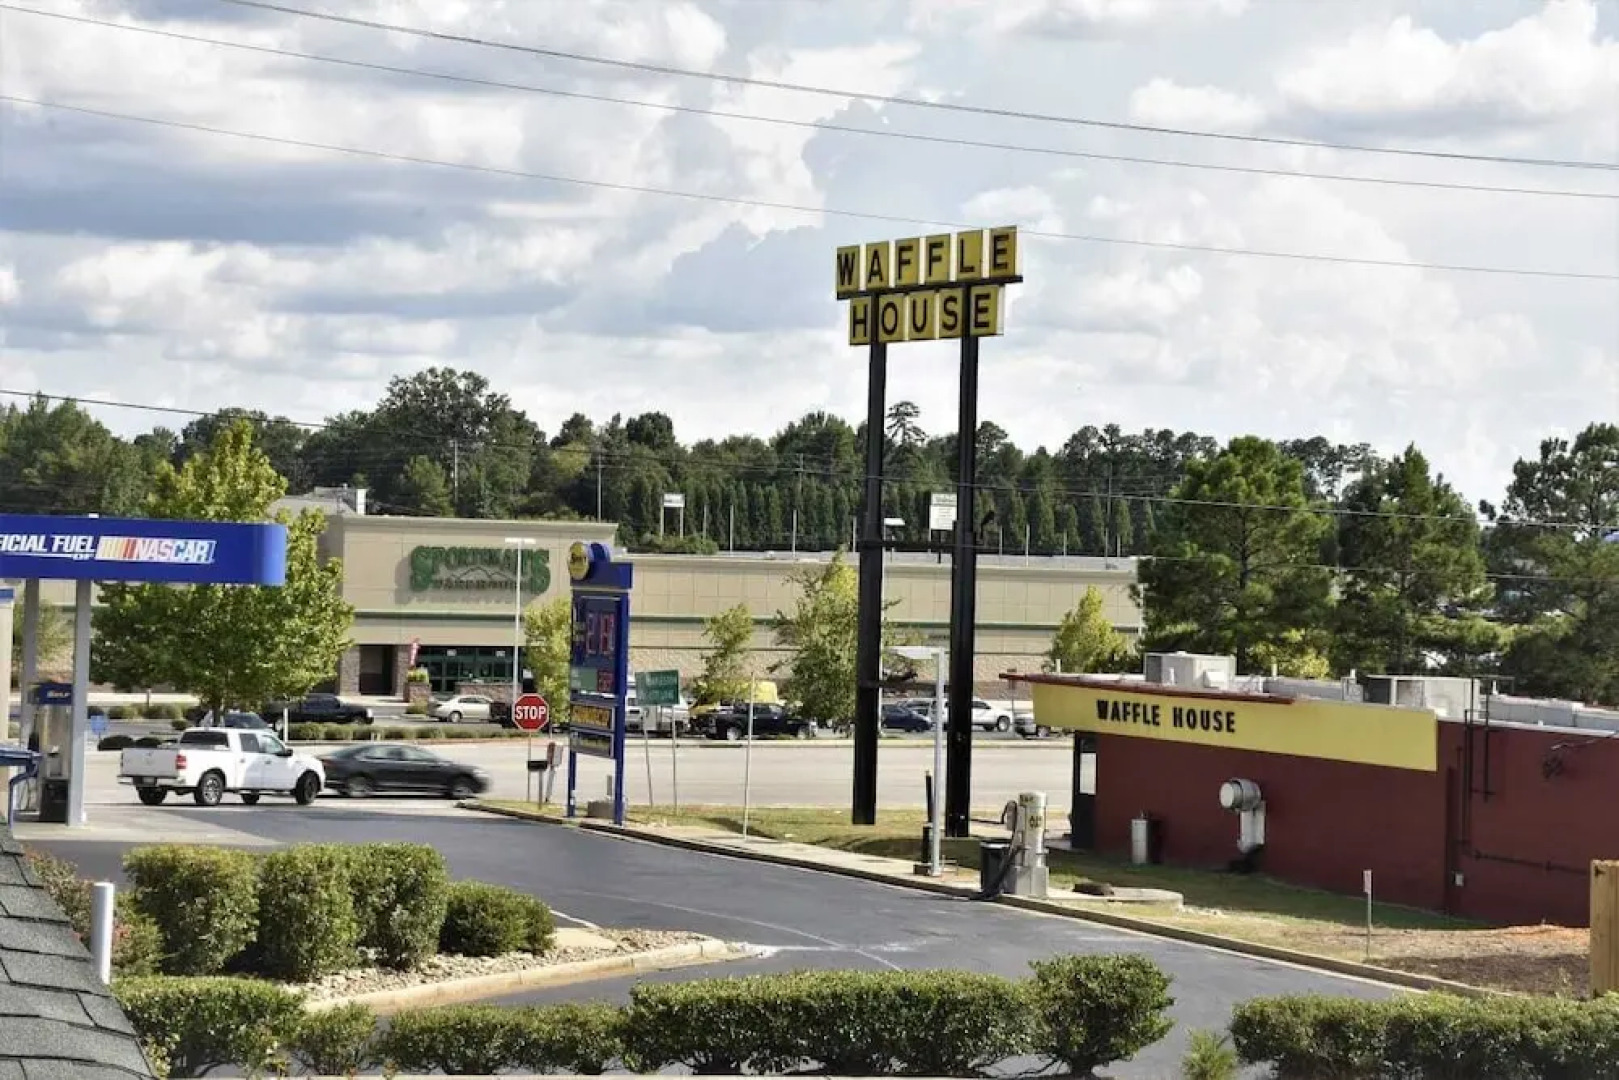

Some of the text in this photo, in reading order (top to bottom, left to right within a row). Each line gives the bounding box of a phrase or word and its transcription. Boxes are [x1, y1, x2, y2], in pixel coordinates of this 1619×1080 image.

[836, 233, 1010, 286] WAFFLE
[852, 292, 992, 338] HOUSE
[52, 535, 96, 553] FUEL
[134, 538, 212, 563] NASCAR
[515, 705, 547, 720] STOP
[1096, 699, 1236, 733] WAFFLE HOUSE
